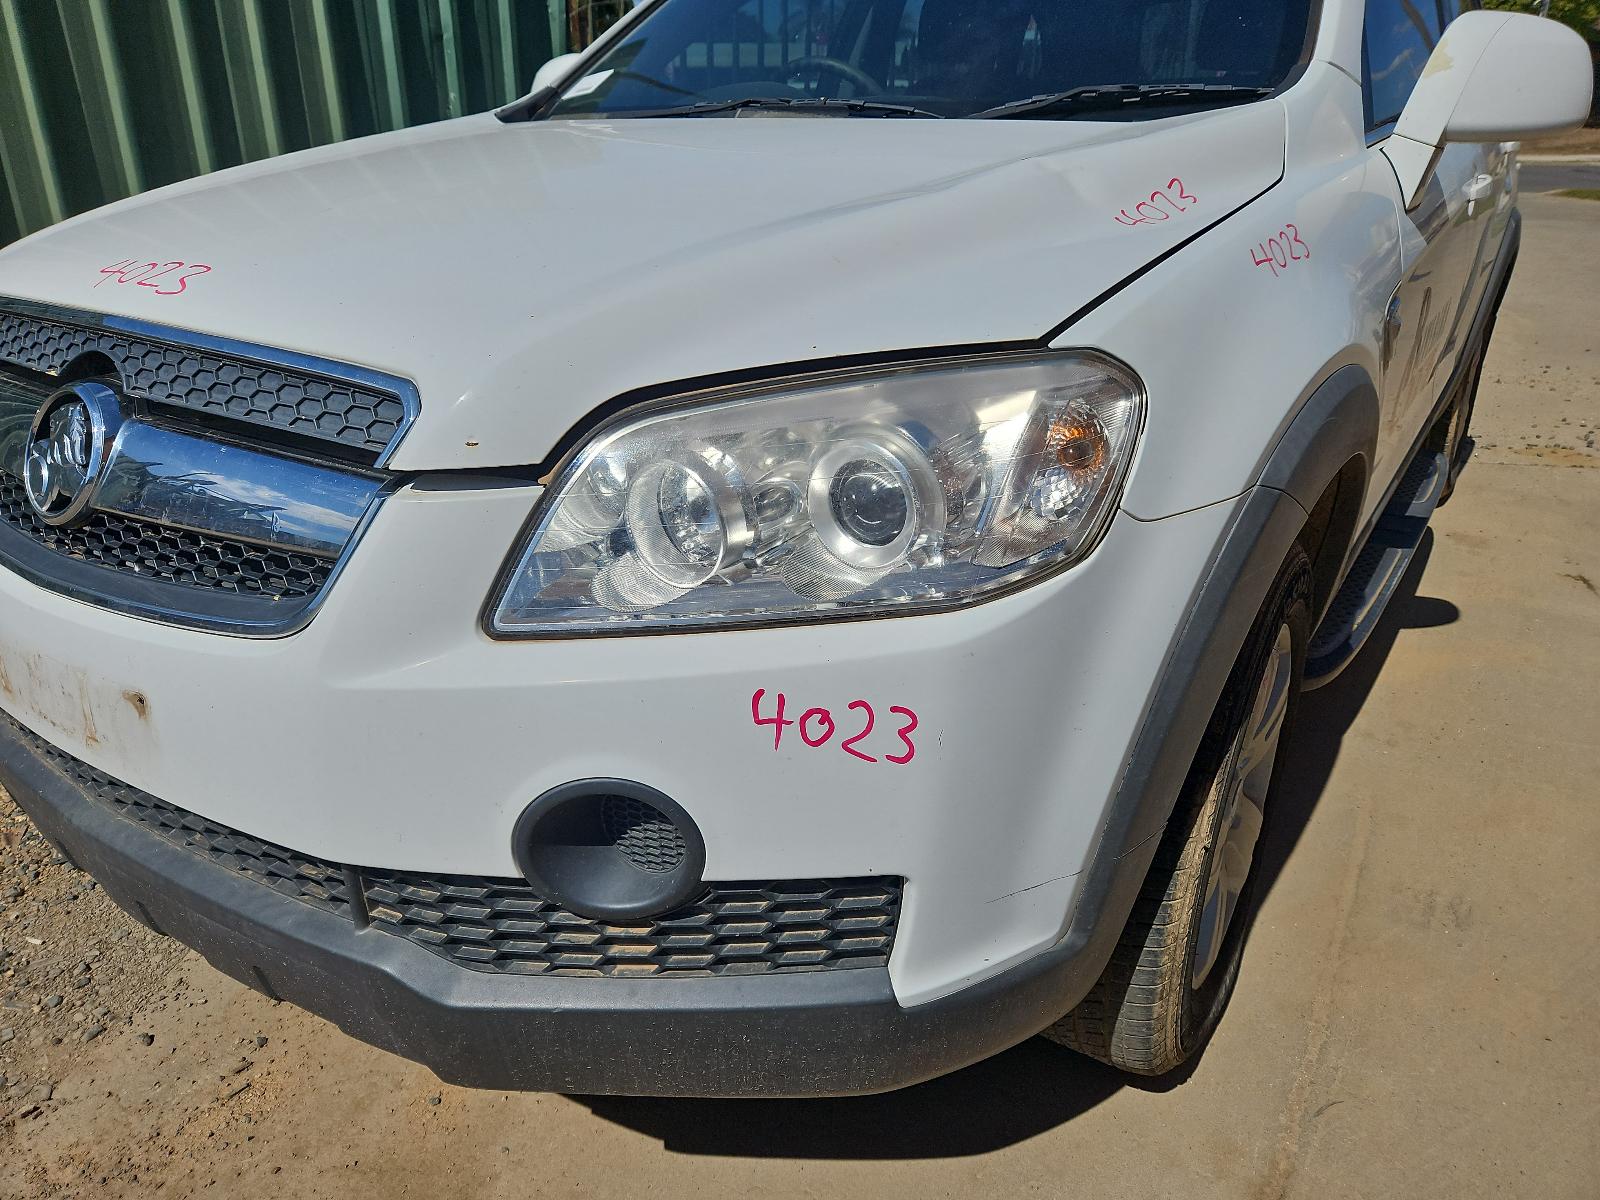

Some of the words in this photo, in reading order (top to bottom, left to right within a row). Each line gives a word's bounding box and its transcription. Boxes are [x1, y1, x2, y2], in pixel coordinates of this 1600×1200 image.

[1114, 177, 1198, 225] 4023
[1250, 223, 1310, 277] 4023
[93, 259, 211, 295] 4023
[752, 688, 919, 764] 4023
